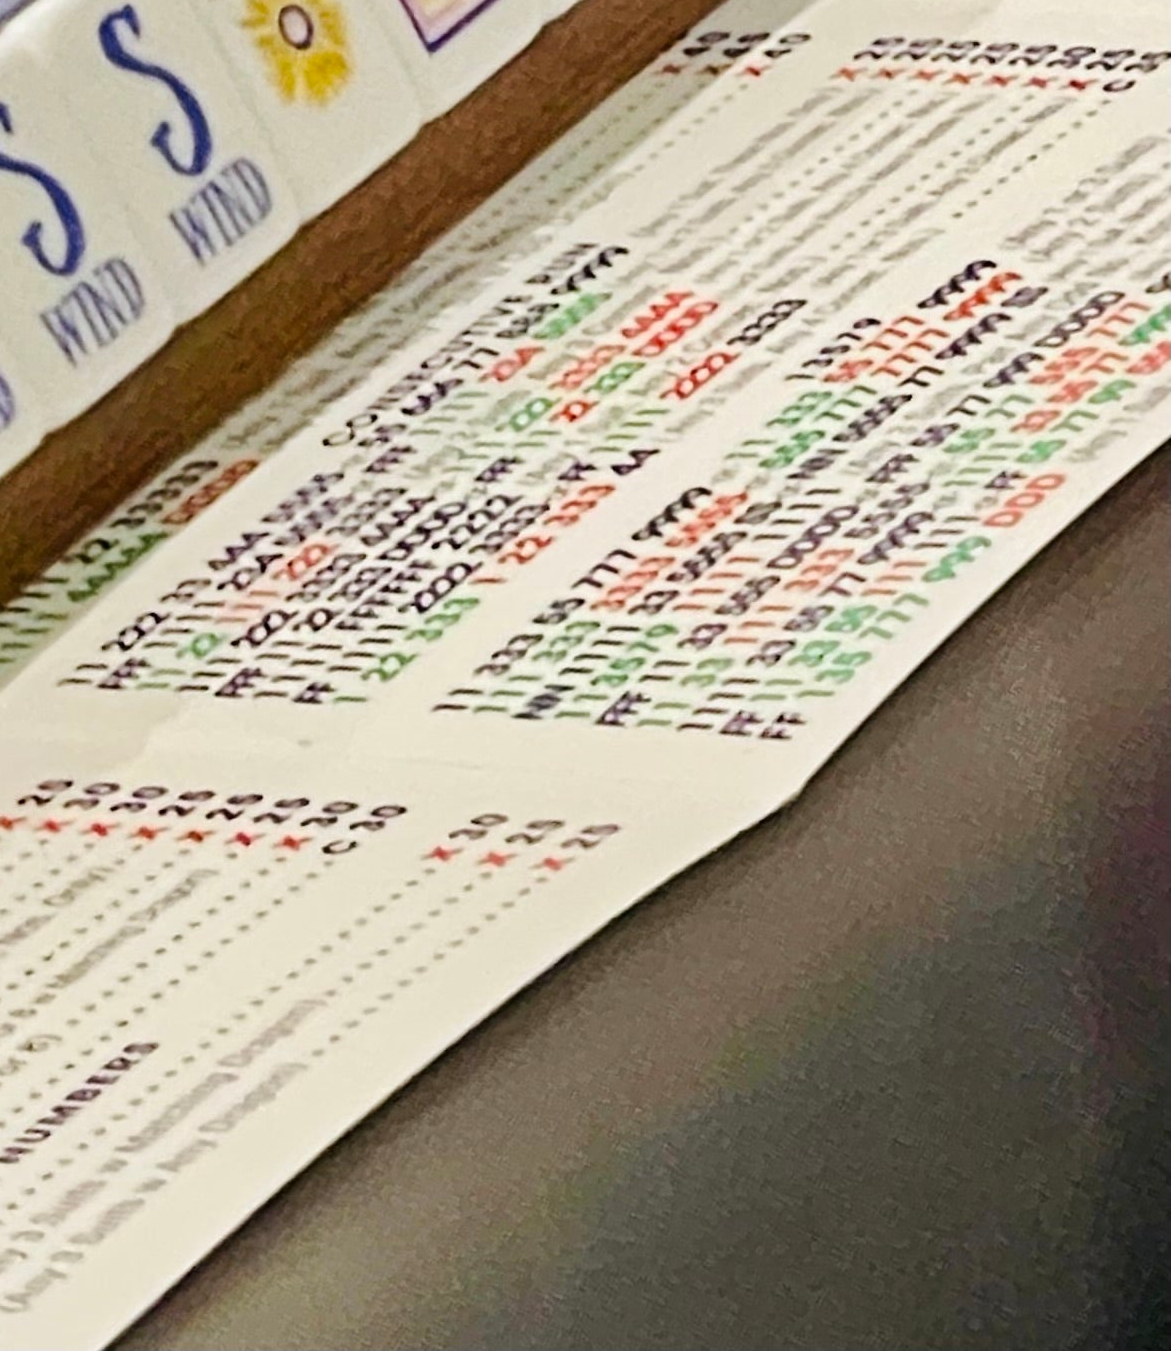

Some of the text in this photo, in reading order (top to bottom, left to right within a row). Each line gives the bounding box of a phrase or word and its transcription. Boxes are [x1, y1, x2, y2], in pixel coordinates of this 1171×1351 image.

[98, 5, 212, 176] S
[168, 157, 273, 267] WIND
[40, 256, 147, 367] WIND
[322, 295, 530, 447] CONSECUTIVE
[525, 242, 596, 284] RUN
[983, 473, 1065, 527] DDD
[360, 651, 417, 682] 22
[497, 535, 553, 564] 22
[610, 448, 660, 476] 44
[571, 548, 637, 589] 777
[818, 571, 867, 597] 77
